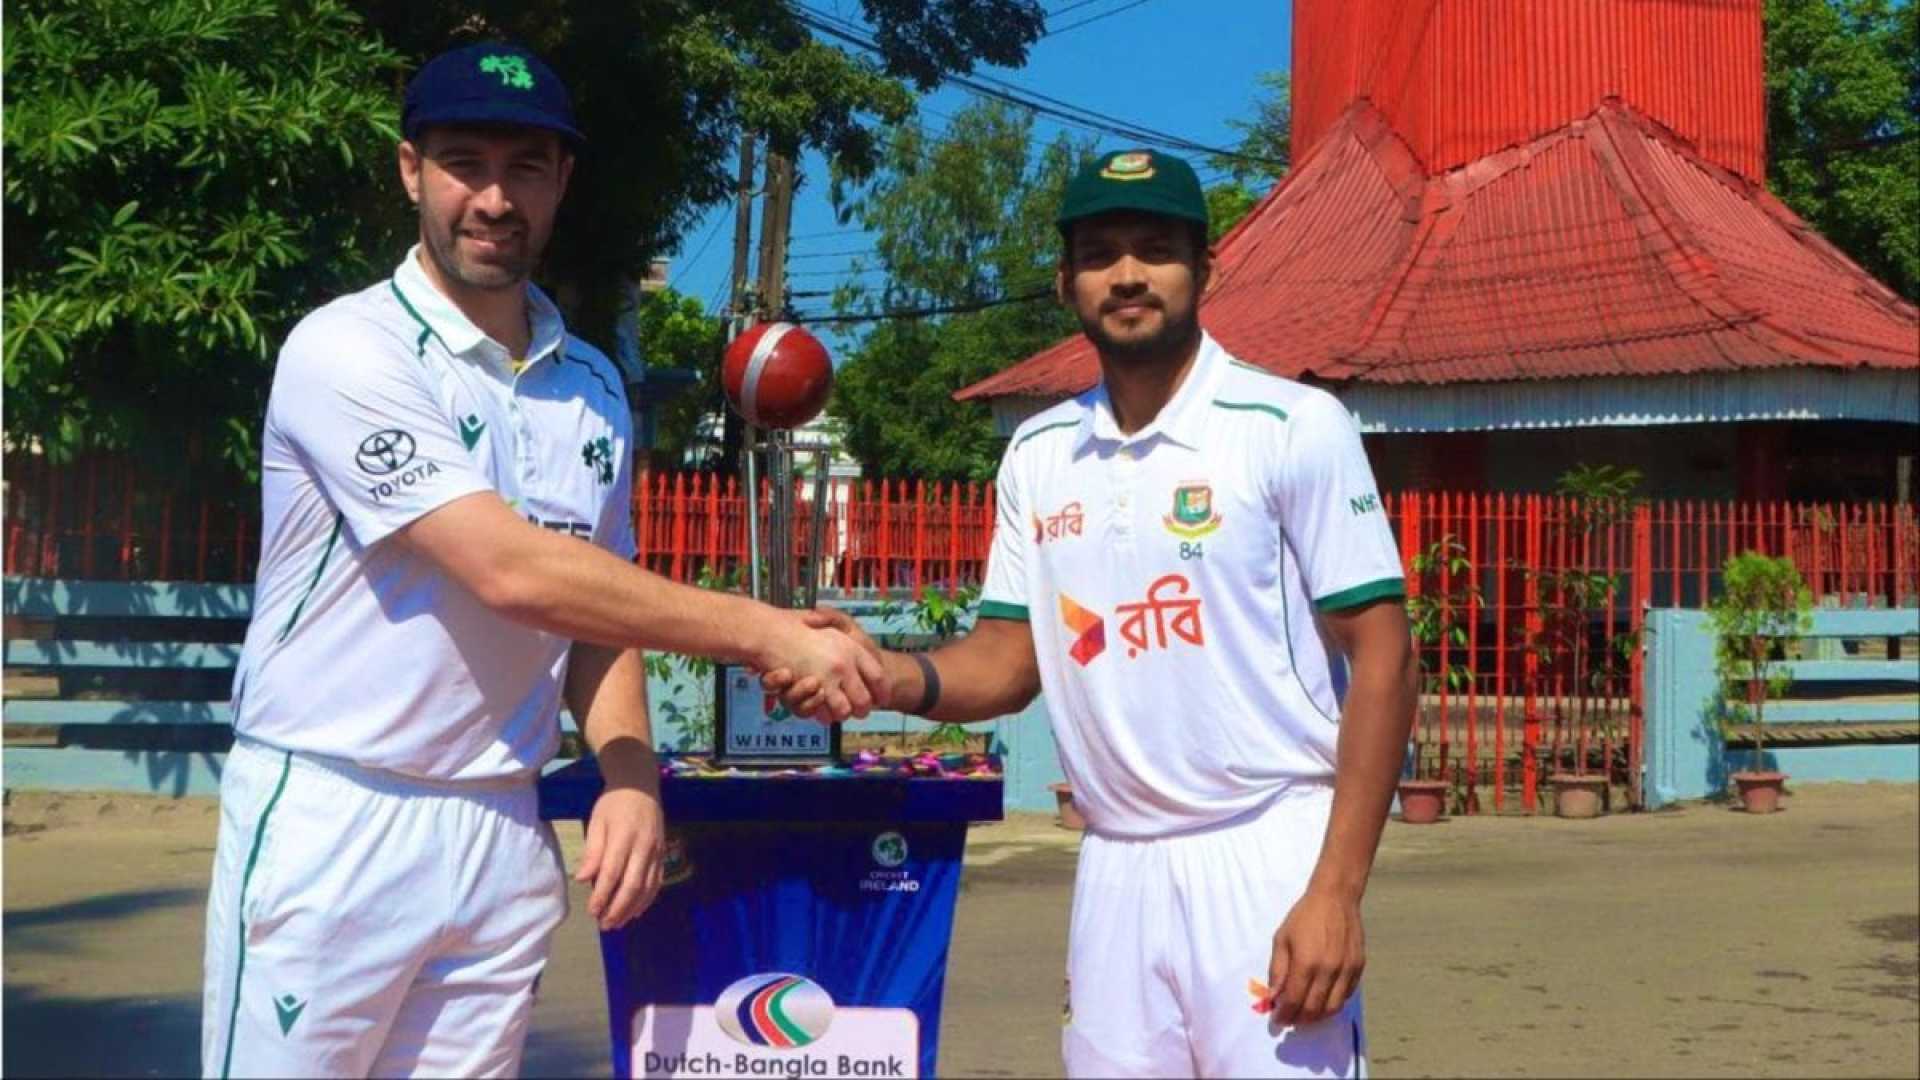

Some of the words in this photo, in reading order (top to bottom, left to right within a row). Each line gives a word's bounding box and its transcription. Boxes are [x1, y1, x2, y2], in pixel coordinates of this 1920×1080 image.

[368, 461, 442, 501] TOYOTA
[1047, 501, 1084, 542] রবি
[1179, 541, 1203, 561] 84
[1115, 573, 1204, 659] রবি
[735, 734, 822, 748] WINNER
[859, 880, 920, 892] IRELAND
[644, 1052, 827, 1079] Dutch-Bangla
[837, 1055, 903, 1076] Bank
